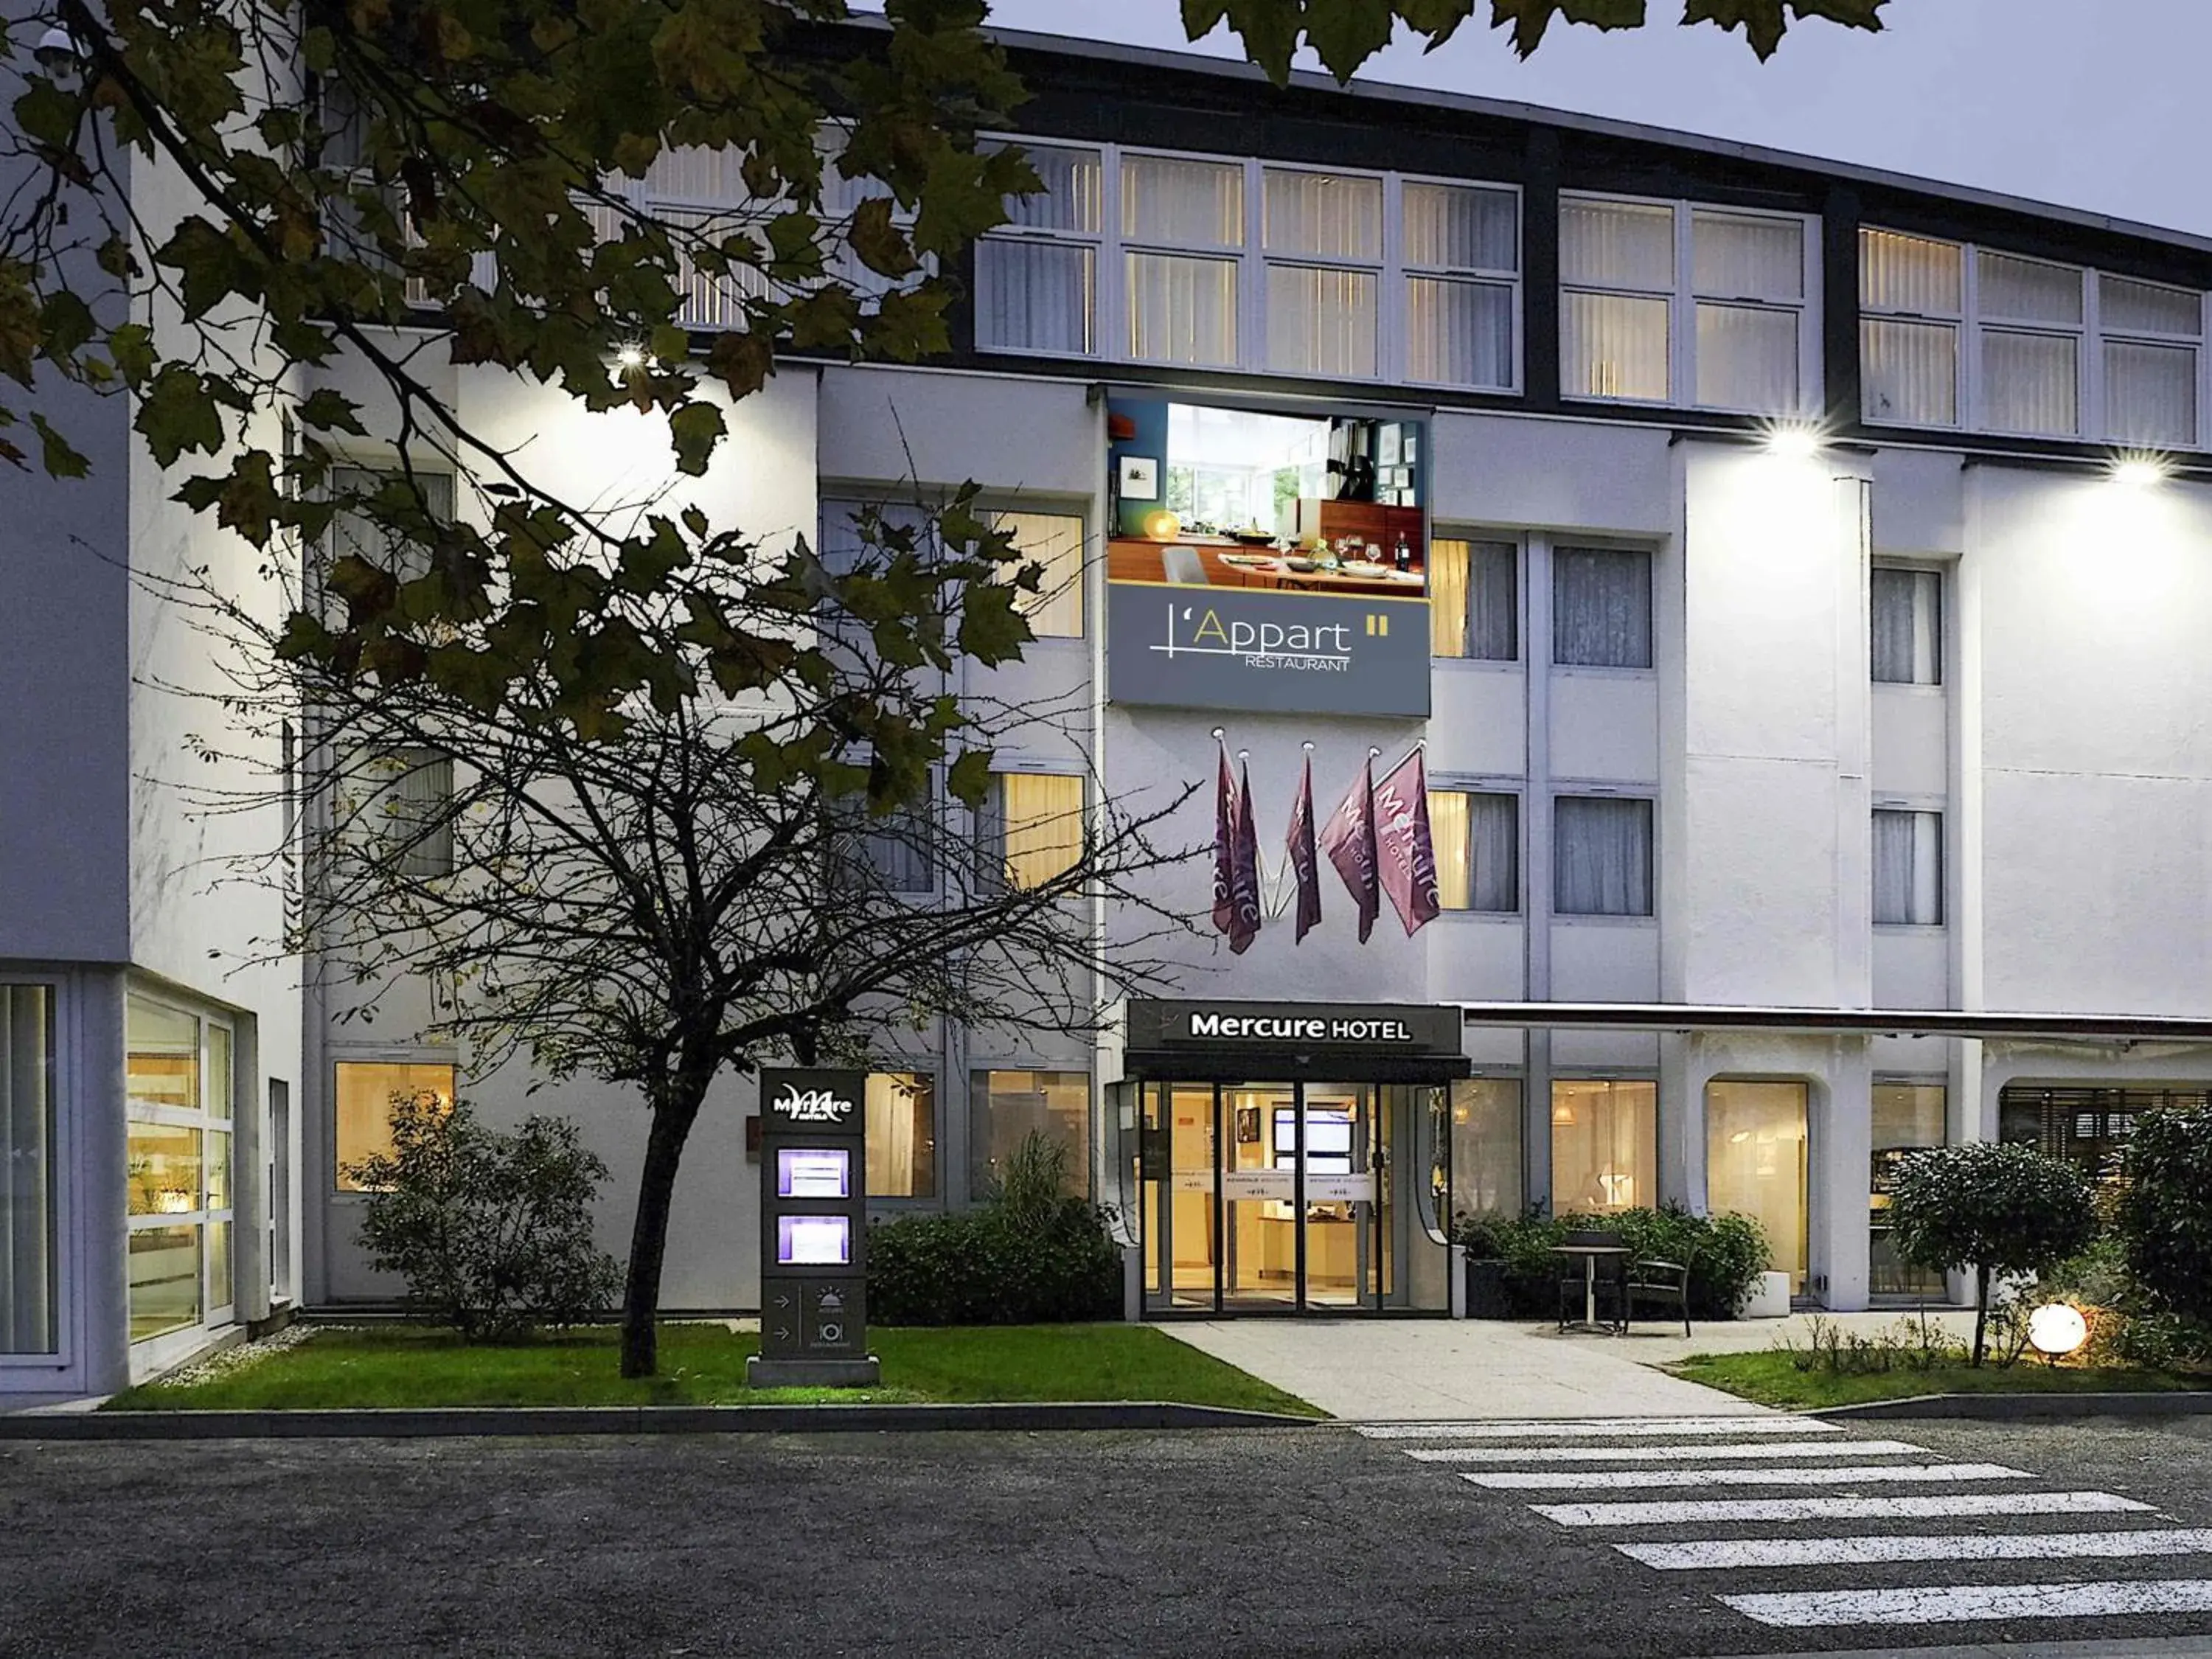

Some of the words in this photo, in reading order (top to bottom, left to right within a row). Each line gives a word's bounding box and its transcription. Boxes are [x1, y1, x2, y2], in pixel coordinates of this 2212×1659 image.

[1245, 654, 1351, 672] RESTAURANT
[1191, 1014, 1326, 1038] Mercure
[1332, 1020, 1411, 1040] HOTEL
